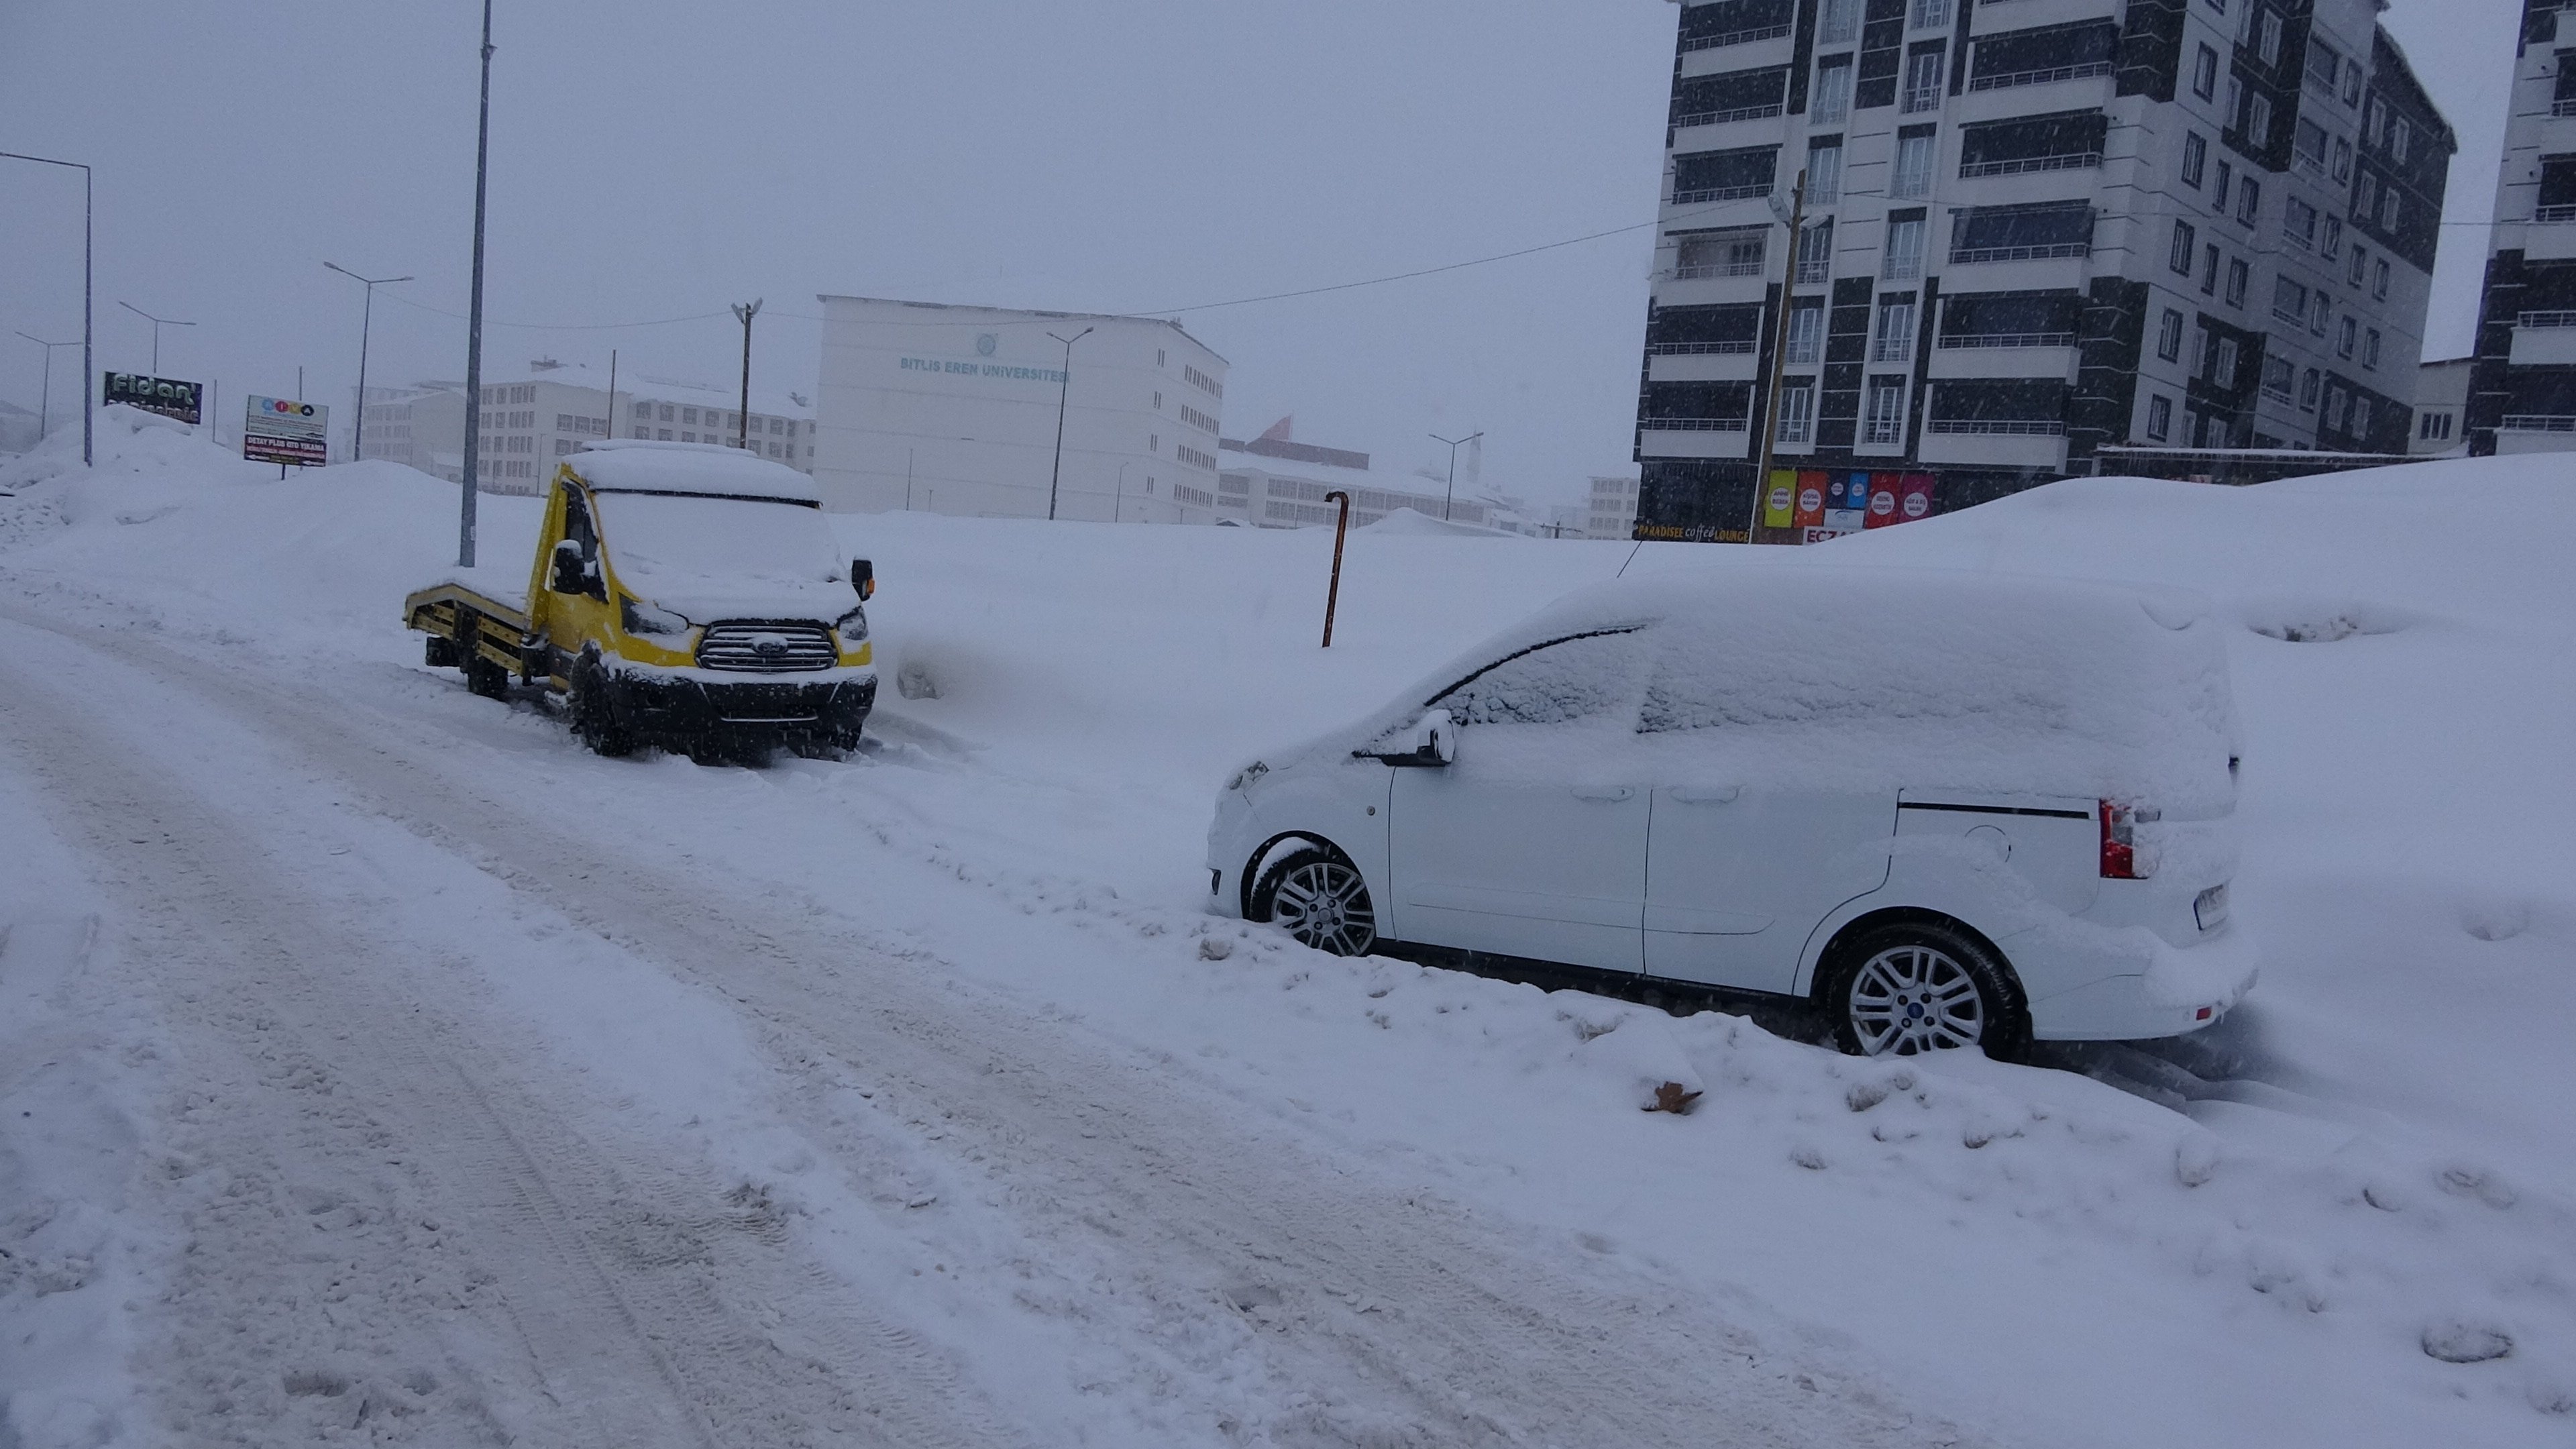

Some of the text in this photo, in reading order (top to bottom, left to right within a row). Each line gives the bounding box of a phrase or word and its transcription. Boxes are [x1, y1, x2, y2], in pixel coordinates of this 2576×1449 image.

[945, 362, 978, 376] EREN
[113, 373, 195, 405] Fidan
[248, 437, 268, 445] DETAY
[268, 439, 286, 447] PLUS
[1638, 525, 1684, 537] PARADISEE
[1715, 529, 1750, 542] LOUNGE
